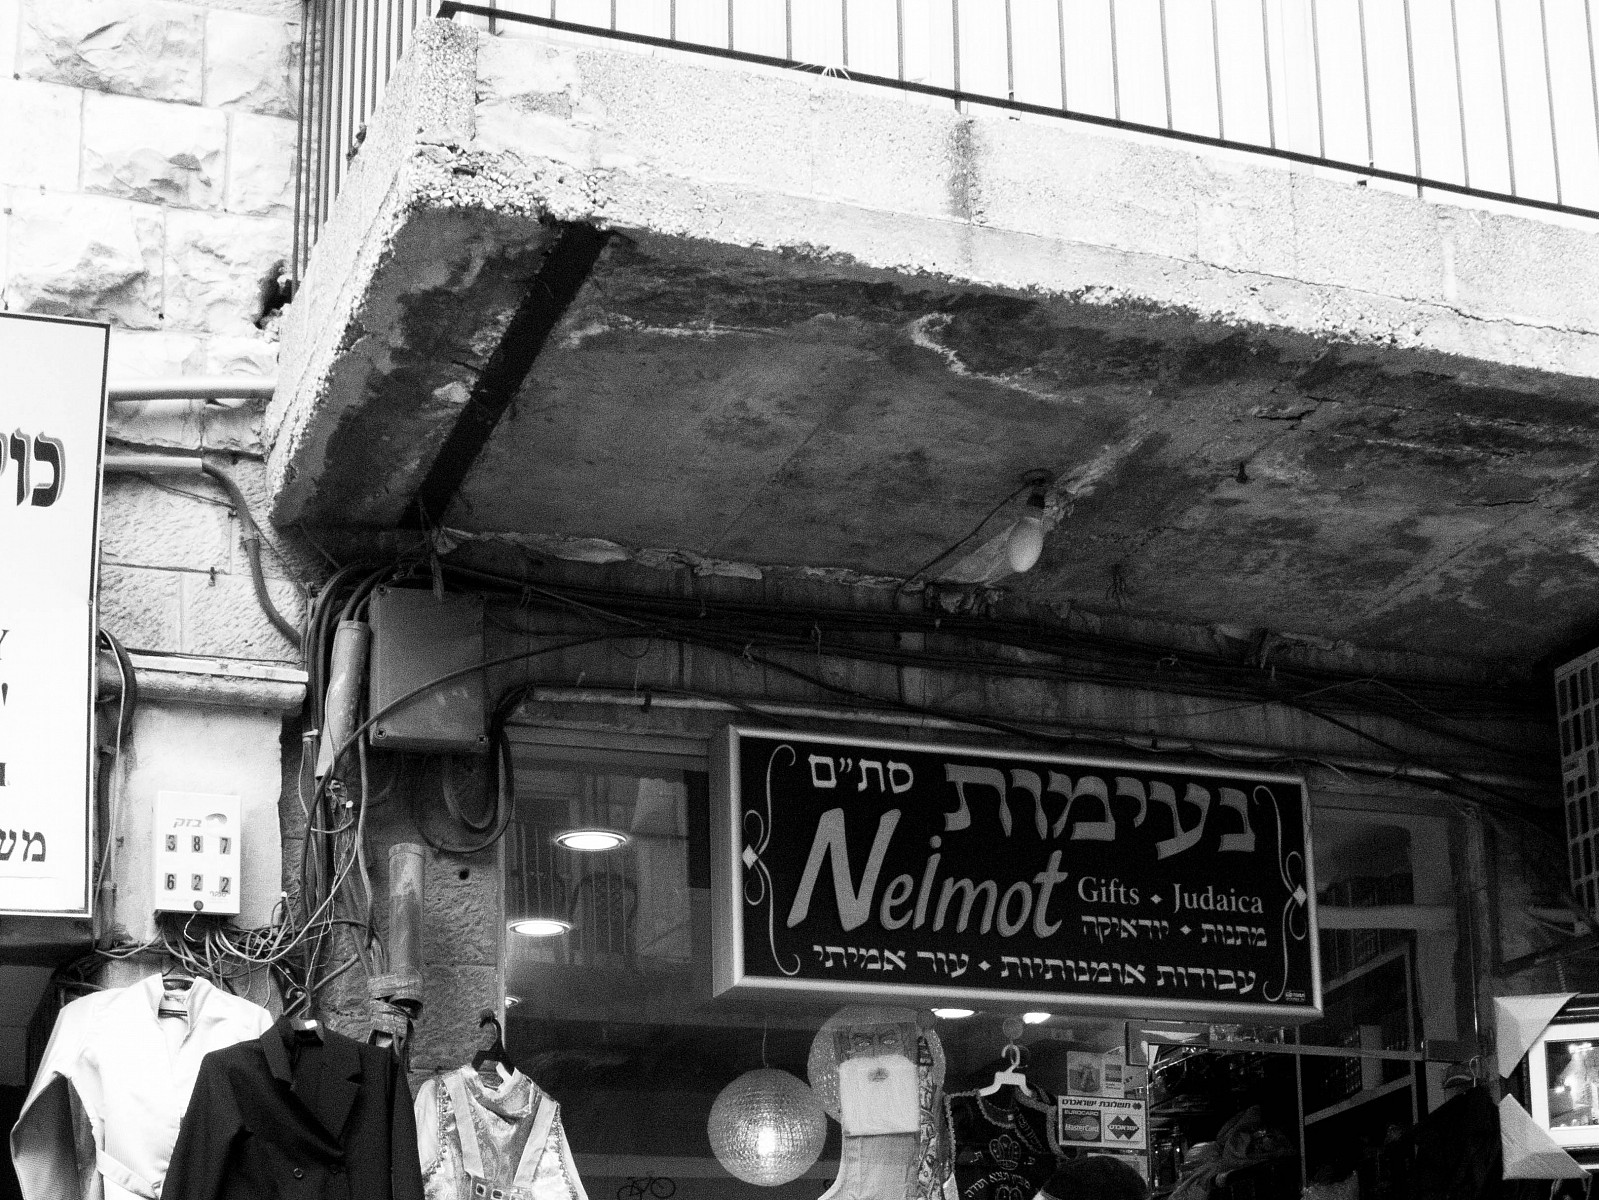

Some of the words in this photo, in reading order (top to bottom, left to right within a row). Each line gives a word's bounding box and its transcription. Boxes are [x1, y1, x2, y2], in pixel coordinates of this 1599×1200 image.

[0, 427, 66, 508] כו
[943, 763, 1256, 860] נעימות
[786, 807, 1068, 938] Neimot
[1077, 876, 1140, 905] Gifts
[1172, 883, 1264, 914] Judaica
[1081, 915, 1170, 944] יודאיקה
[1201, 923, 1267, 947] מתנות
[812, 944, 907, 971] אמיתי
[916, 950, 969, 978] עור
[1000, 956, 1146, 985] אומנותיות
[1156, 965, 1256, 994] עבודות
